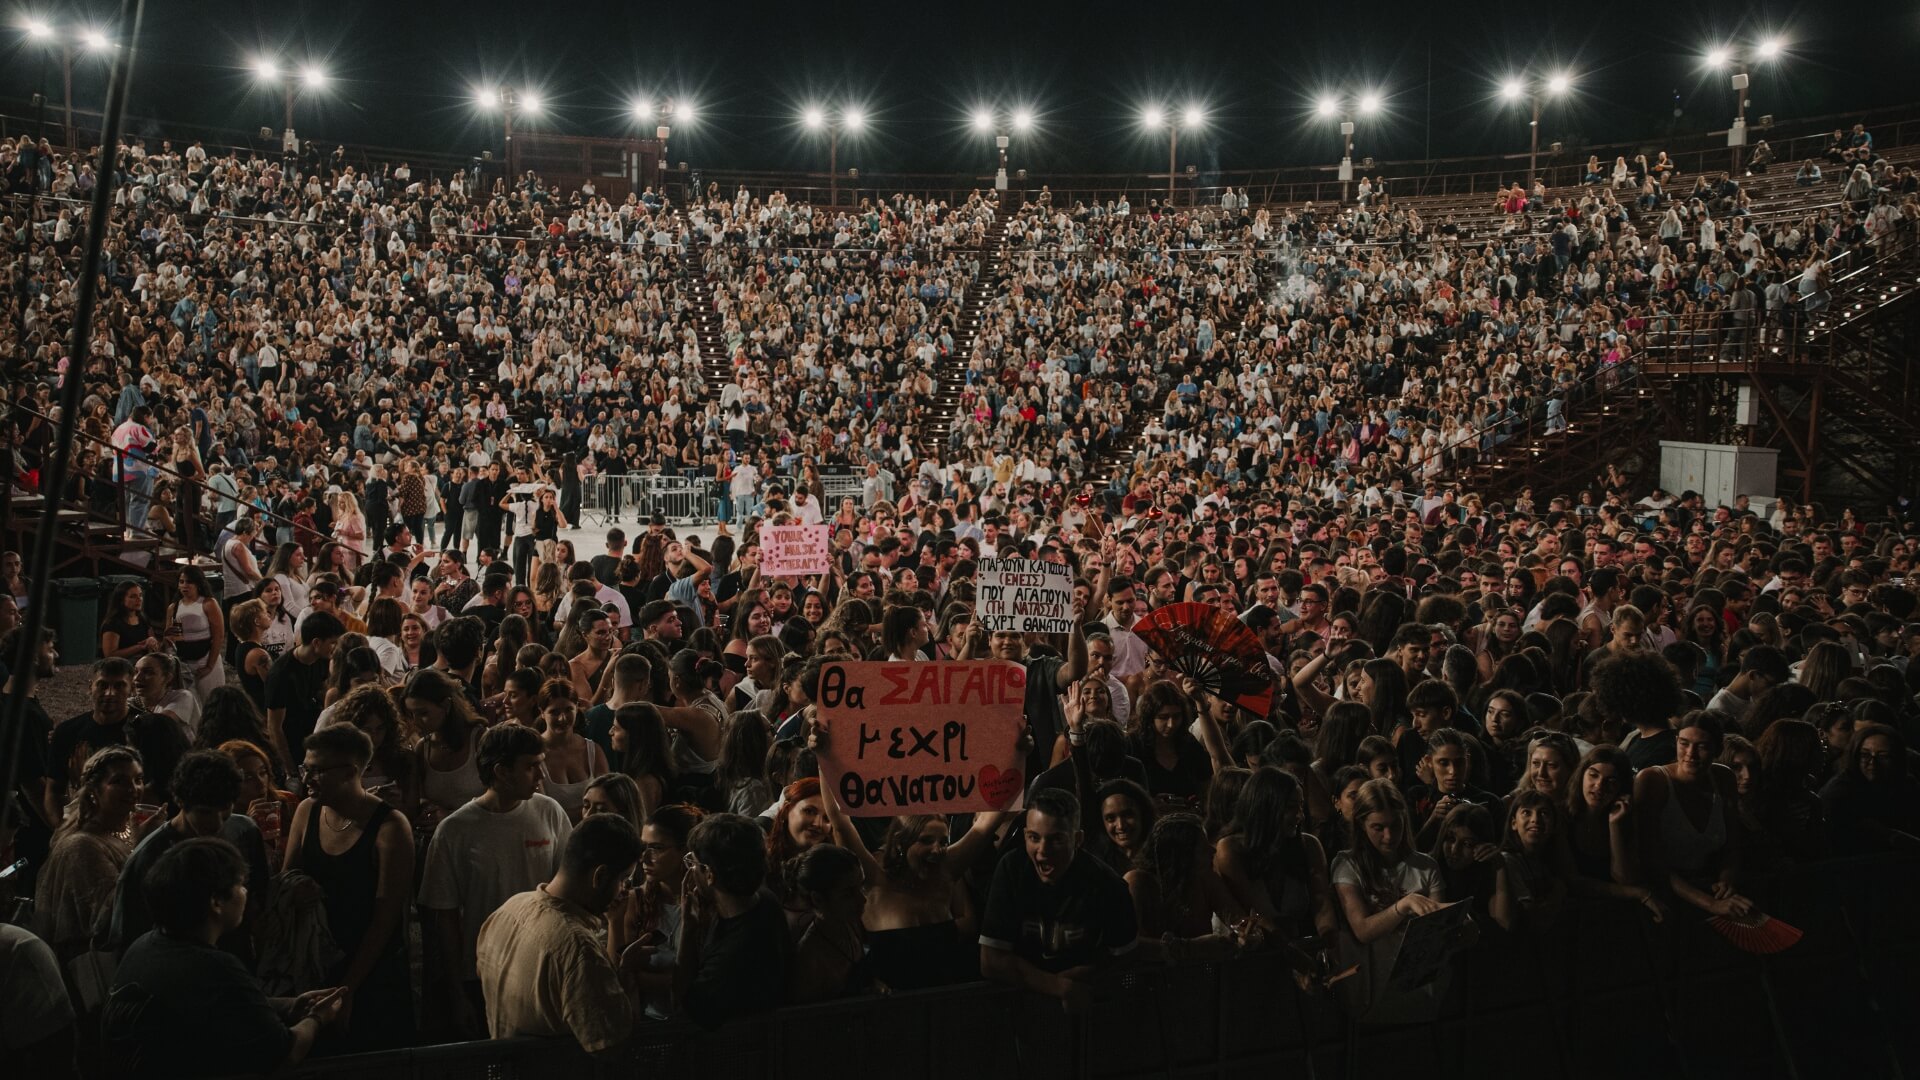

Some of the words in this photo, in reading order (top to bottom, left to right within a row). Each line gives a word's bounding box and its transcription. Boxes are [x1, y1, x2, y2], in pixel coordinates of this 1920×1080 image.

[778, 558, 819, 570] THERAPY
[978, 557, 1025, 573] ΥΠΑΡΧΟΥΝ
[999, 572, 1045, 587] (ΕΜΕΙΣ)
[981, 585, 1005, 600] ΠΟΥ
[1014, 587, 1071, 604] ΑΓΑΠΟΥΝ
[986, 600, 1005, 614] (ΤΗ
[1012, 601, 1065, 618] ΝΑΤΑΣΣΑ)
[1023, 617, 1074, 632] ΘΑΝΑΤΟΥ
[880, 664, 1027, 706] ΣΑΓΑΠΩ
